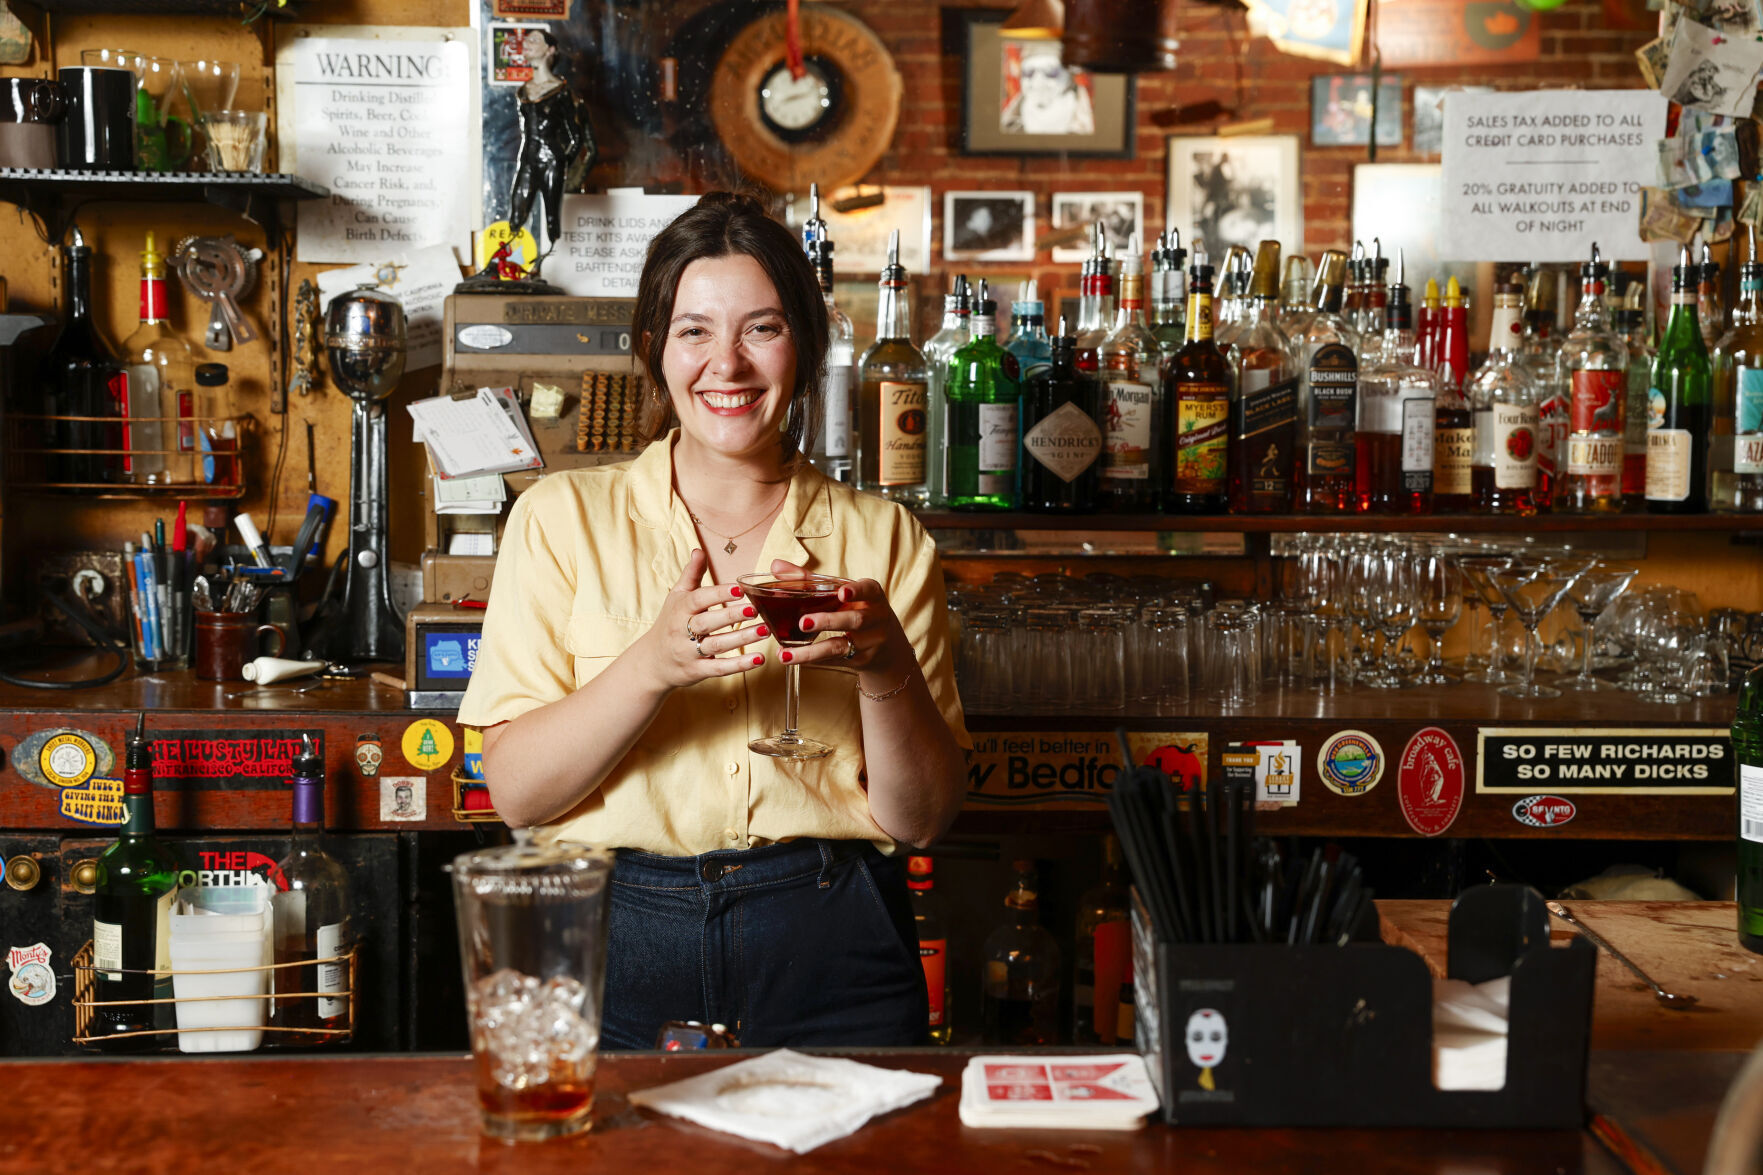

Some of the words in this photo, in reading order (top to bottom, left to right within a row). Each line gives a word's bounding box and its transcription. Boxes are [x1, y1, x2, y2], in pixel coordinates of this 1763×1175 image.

[332, 90, 385, 105] Drinking
[1467, 116, 1508, 128] SALES
[1512, 116, 1537, 128] TAX
[1541, 115, 1590, 128] ADDED
[1596, 115, 1614, 127] TO
[1620, 115, 1643, 127] ALL
[339, 125, 369, 137] Wine
[373, 126, 394, 138] and
[397, 126, 432, 138] Other
[1465, 135, 1512, 147] CREDIT
[1517, 134, 1555, 147] CARD
[1561, 133, 1643, 146] PURCHASES
[327, 142, 382, 155] Alcoholic
[387, 143, 443, 158] Beverages
[347, 160, 372, 174] May
[377, 160, 424, 173] Increase
[334, 176, 375, 189] Cancer
[1462, 183, 1492, 195] 20%
[1497, 183, 1564, 195] GRATUITY
[1568, 182, 1617, 194] ADDED
[1623, 182, 1641, 194] TO
[332, 194, 374, 209] During
[1472, 202, 1493, 214] ALL
[1498, 201, 1575, 214] WALKOUTS
[1580, 201, 1596, 213] AT
[1601, 201, 1631, 213] END
[355, 211, 378, 224] Can
[383, 211, 418, 224] Cause
[578, 217, 616, 228] DRINK
[619, 217, 647, 228] LIDS
[1516, 220, 1535, 232] OF
[1540, 220, 1585, 232] NIGHT
[346, 228, 376, 241] Birth
[564, 231, 592, 243] TEST
[596, 231, 622, 243] KITS
[570, 247, 612, 258] PLEASE
[616, 247, 643, 258] ASK
[602, 277, 639, 289] DETA
[587, 304, 632, 320] MESS
[1310, 371, 1357, 382] BUSHMILLS
[892, 387, 926, 405] Tito
[1116, 387, 1149, 405] Morgan
[1498, 413, 1519, 424] Four
[1031, 437, 1099, 448] HENDRICK
[1447, 446, 1472, 458] Ma
[1571, 443, 1619, 465] CZADO
[1264, 481, 1274, 490] 12
[152, 740, 181, 761] HE
[184, 740, 257, 761] LUSTY
[261, 740, 320, 761] LAD
[974, 738, 997, 752] u'll
[1003, 738, 1034, 753] feel
[1040, 738, 1091, 753] better
[1095, 740, 1110, 753] in
[1402, 734, 1447, 770] broadway
[1444, 747, 1460, 770] cafe
[1502, 744, 1536, 759] SO
[1544, 744, 1592, 759] FEW
[1600, 744, 1724, 759] RICHARDS
[166, 764, 234, 775] FRANCISCO
[242, 764, 294, 775] CALIFOR
[1008, 756, 1122, 789] Bedfo
[1517, 765, 1551, 779] SO
[1559, 765, 1627, 779] MANY
[1635, 764, 1709, 779] DICKS
[65, 791, 95, 802] GIVING
[98, 793, 114, 802] THE
[65, 803, 71, 812] A
[75, 803, 94, 819] LIFT
[198, 851, 246, 870] THE
[8, 946, 48, 968] Monty's
